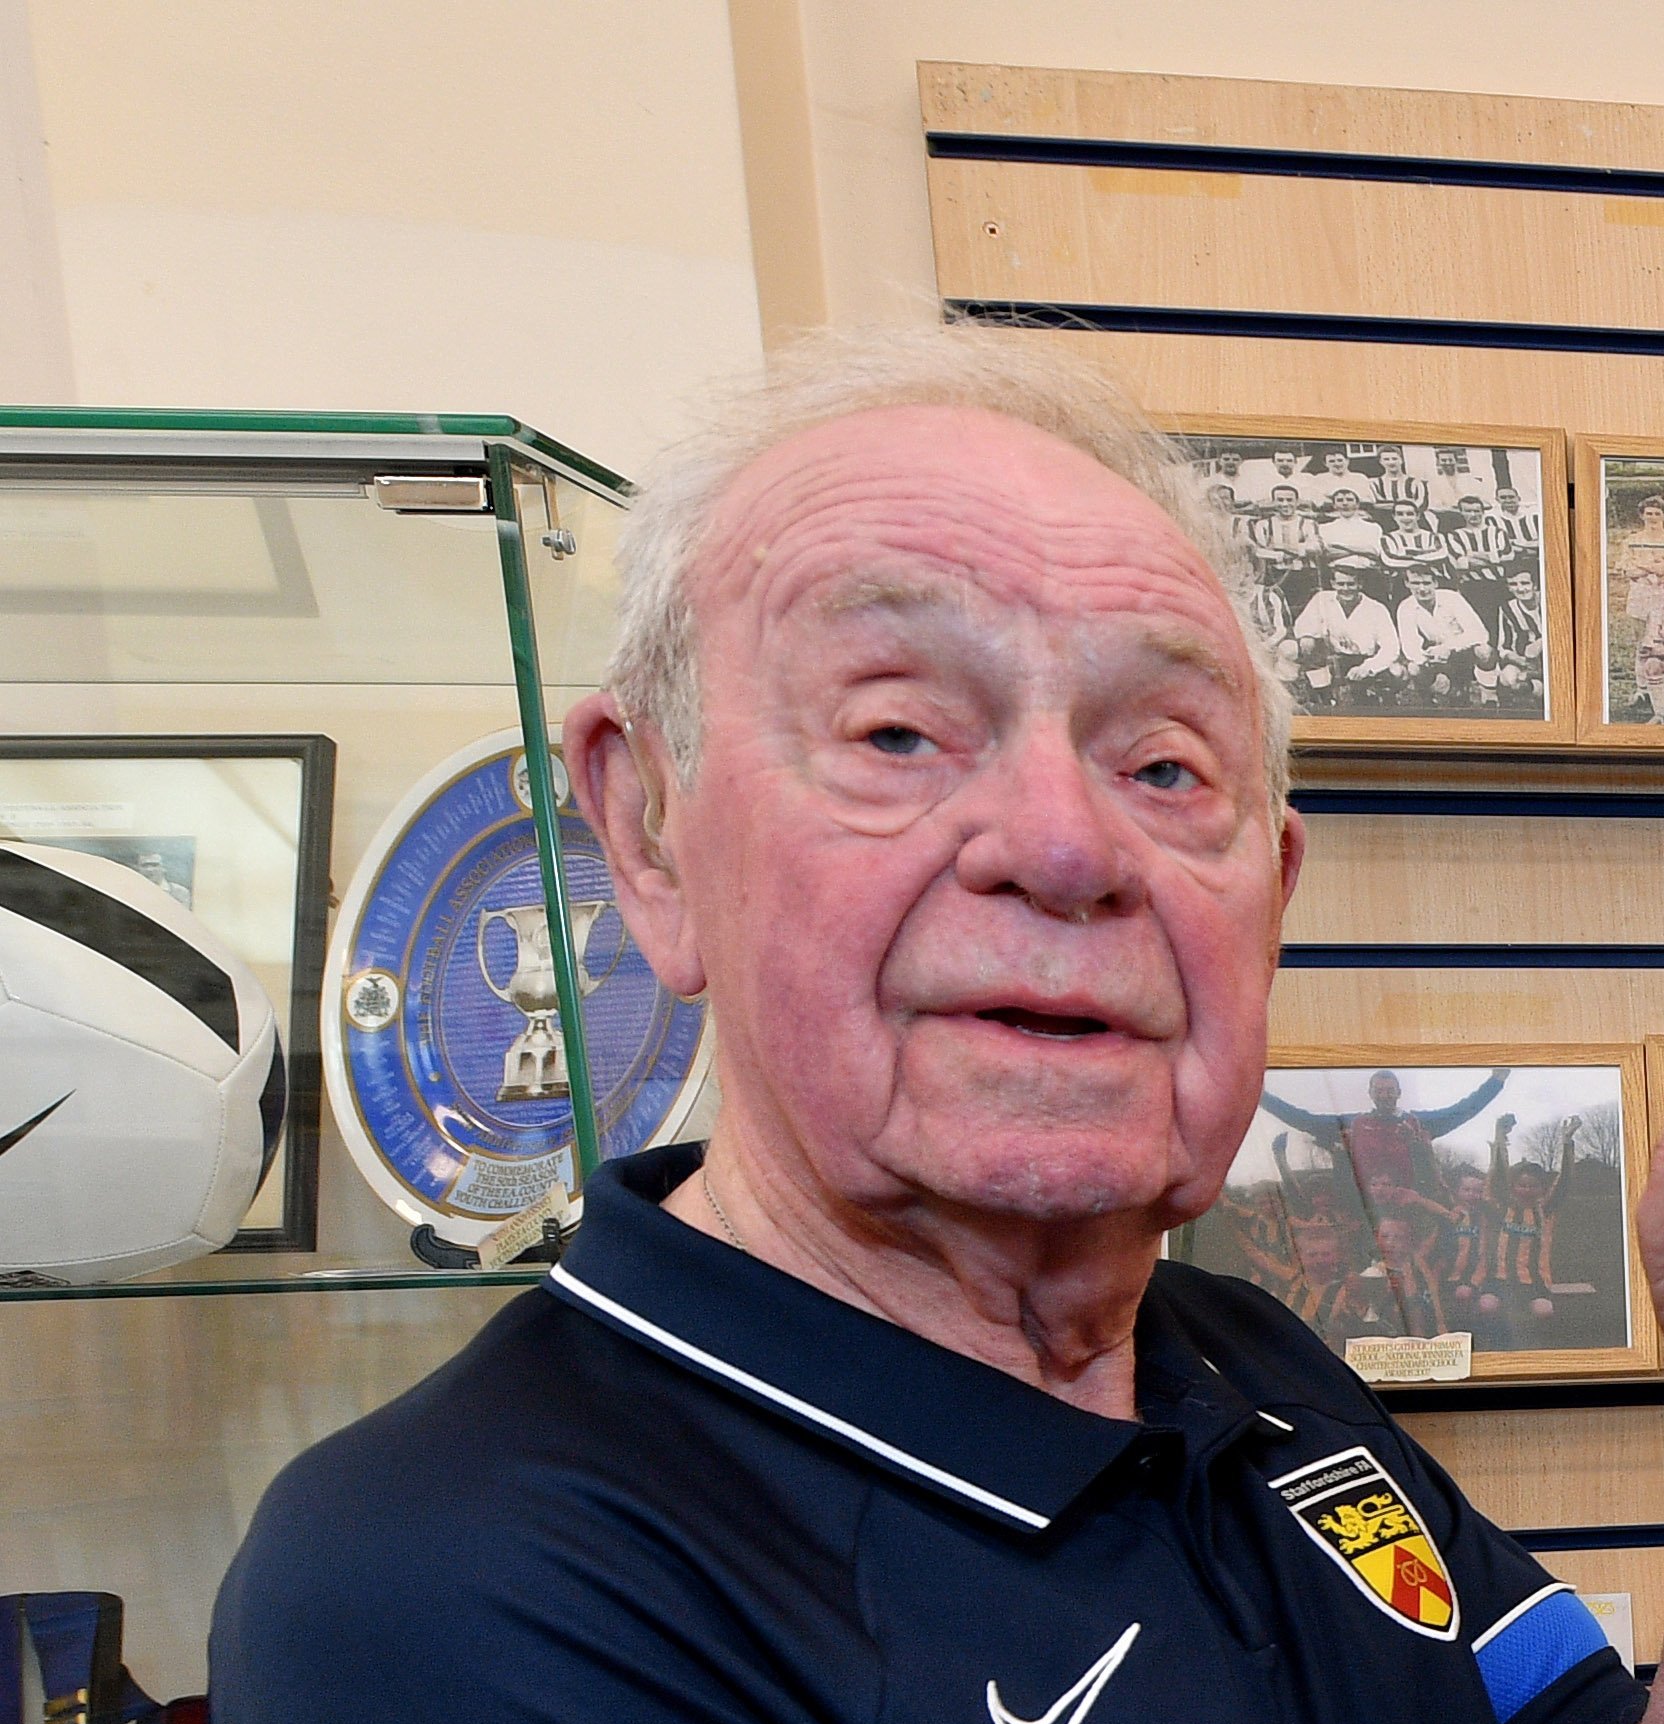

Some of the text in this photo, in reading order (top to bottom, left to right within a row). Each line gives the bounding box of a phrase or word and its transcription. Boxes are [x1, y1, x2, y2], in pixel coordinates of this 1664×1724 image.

[487, 1154, 564, 1175] COMMEMORATE
[1281, 1460, 1372, 1500] Staffordshire FA
